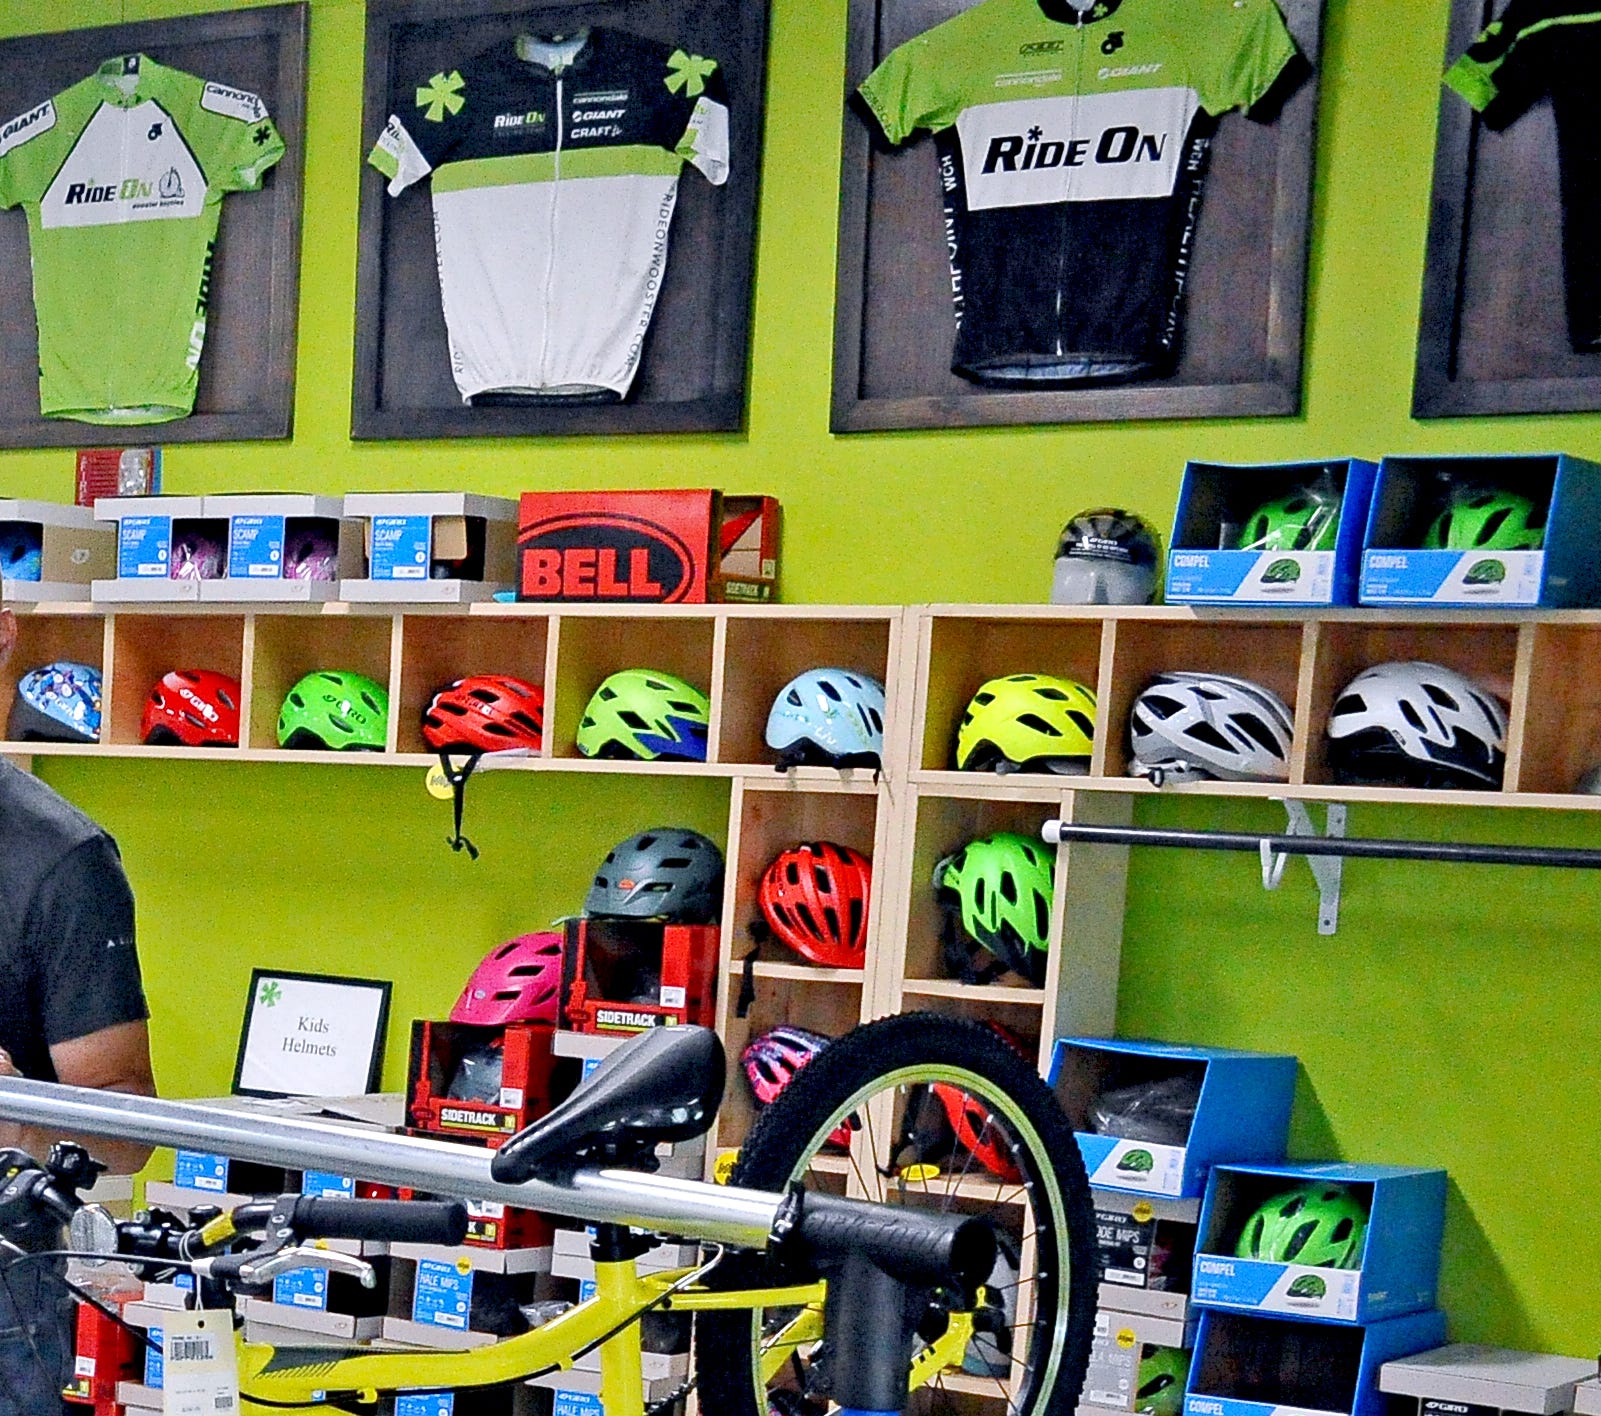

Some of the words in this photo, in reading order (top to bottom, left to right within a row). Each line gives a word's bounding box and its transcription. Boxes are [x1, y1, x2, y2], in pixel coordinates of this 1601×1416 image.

[2, 104, 49, 140] GIANT
[582, 109, 626, 121] GIANT
[570, 125, 612, 139] CRAFT
[1095, 126, 1168, 165] ON
[122, 529, 147, 541] SCAMP
[233, 529, 259, 541] SCAMP
[374, 529, 403, 541] SCAMP
[1174, 554, 1210, 568] COMPEL
[1368, 555, 1409, 569] COMPEL
[523, 548, 663, 597] BELL
[336, 699, 367, 725] GRO
[298, 1016, 330, 1034] Kids
[596, 1009, 656, 1028] SIDETRACK
[282, 1037, 337, 1057] Helmets
[440, 1108, 497, 1127] SIDETRACK
[1116, 1228, 1140, 1244] MIPS
[1200, 1260, 1236, 1277] COMPEL
[420, 1272, 439, 1286] HALE
[441, 1276, 459, 1290] MIPS
[557, 1404, 578, 1416] HALE
[1189, 1400, 1225, 1416] COMPEL
[1439, 1402, 1469, 1414] GIRO
